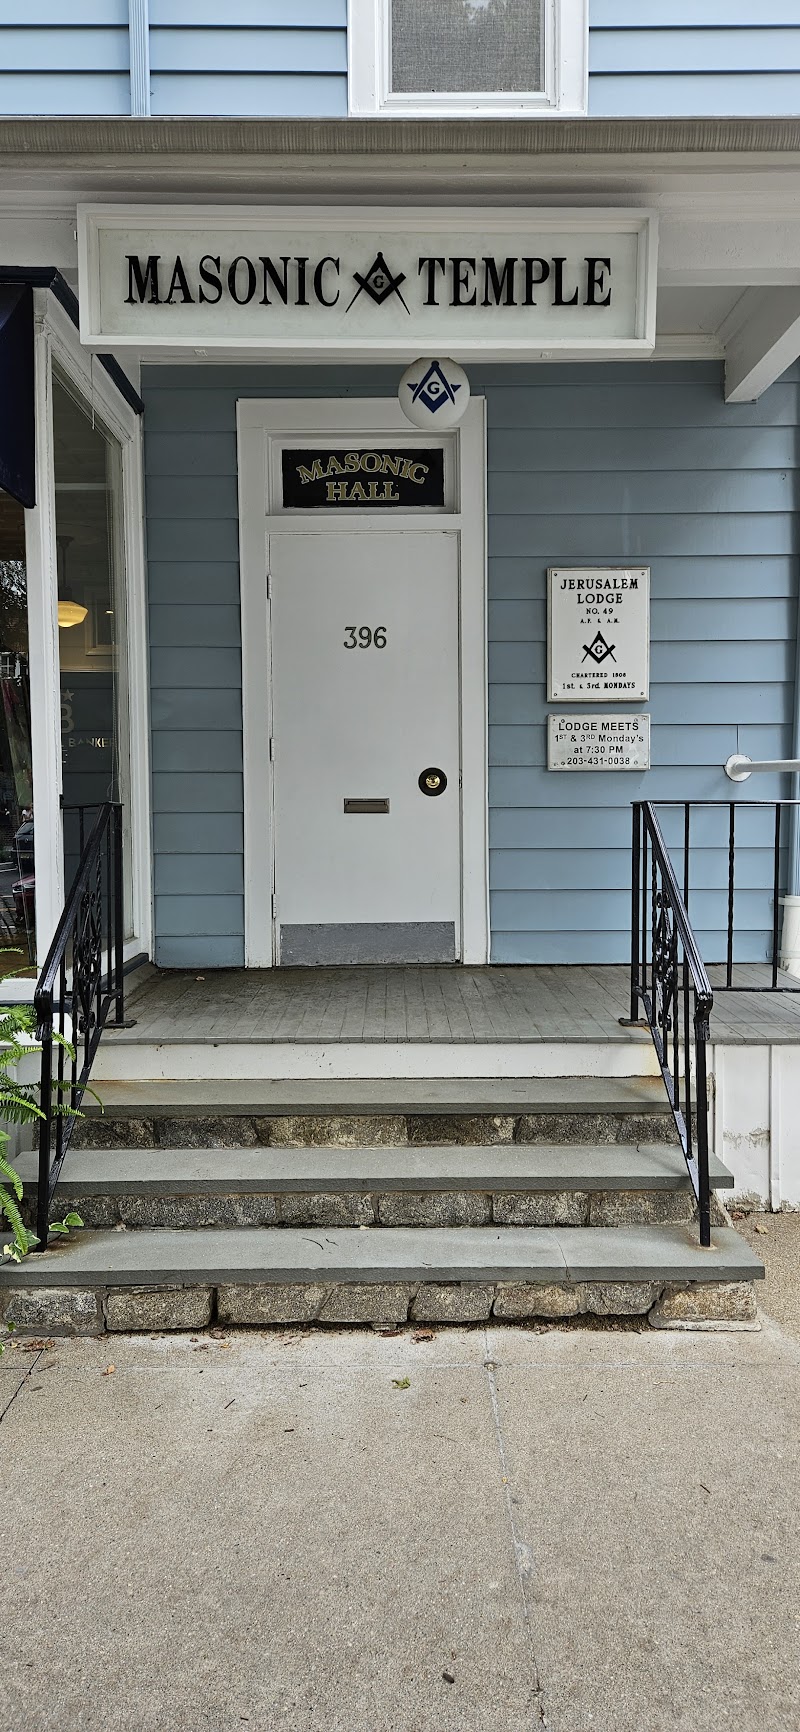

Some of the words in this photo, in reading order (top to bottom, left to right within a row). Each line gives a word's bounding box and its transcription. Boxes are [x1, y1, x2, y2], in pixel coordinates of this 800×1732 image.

[124, 255, 341, 307] MASONIC
[418, 257, 613, 307] TEMPLE
[426, 381, 440, 395] G
[296, 452, 429, 484] MASONIC
[326, 482, 400, 501] HALL
[560, 578, 639, 590] JERUSALEM
[577, 593, 624, 604] LODGE
[343, 626, 387, 650] 396
[558, 722, 598, 731] LODGE
[601, 722, 639, 731] MEETS
[554, 734, 568, 742] 1ST
[570, 734, 577, 742] &
[580, 734, 596, 742] 3RD
[598, 734, 644, 744] Monday's
[586, 746, 606, 754] 7:30
[608, 746, 624, 754] PM
